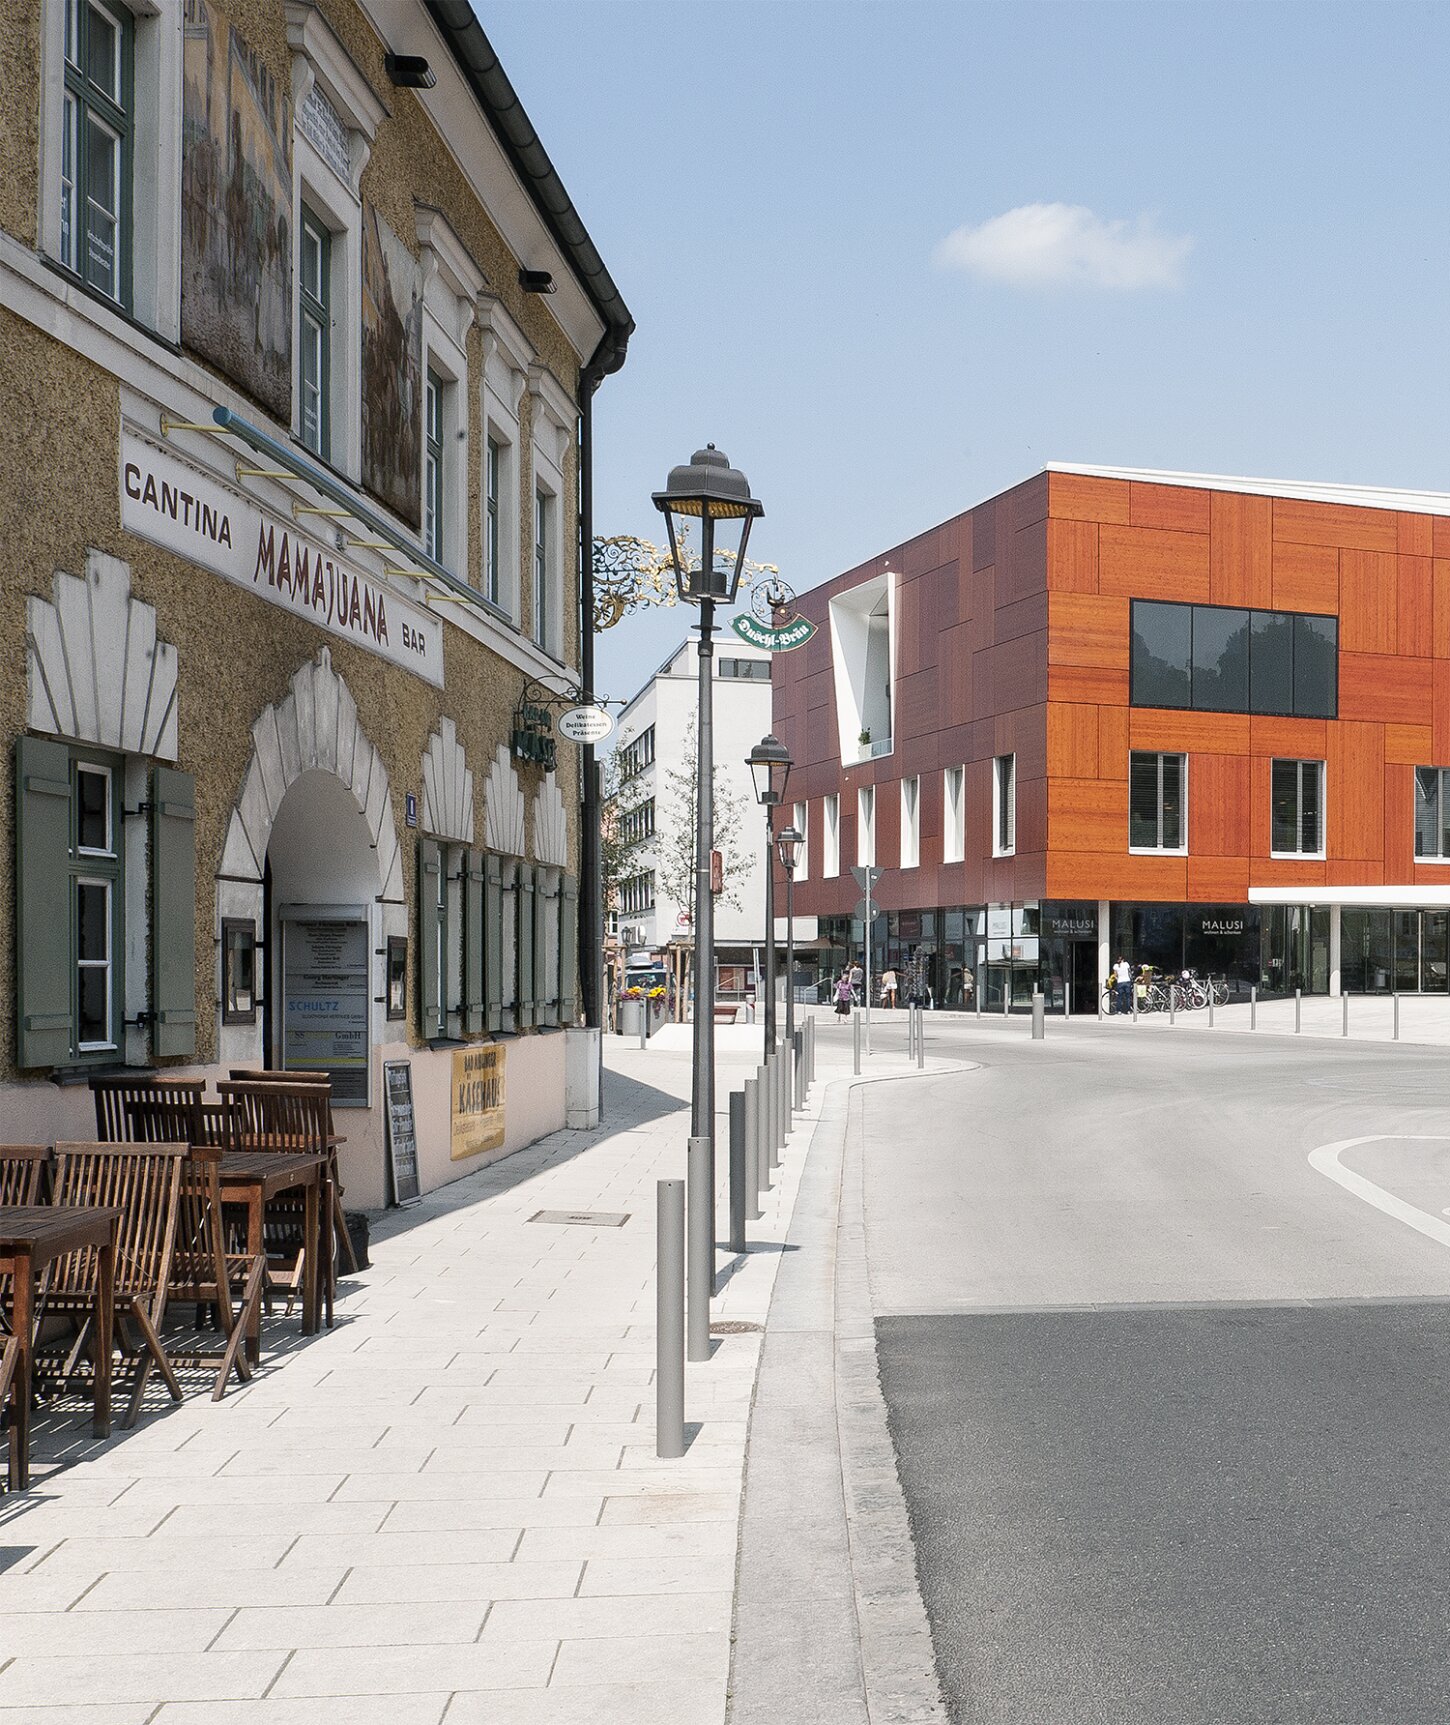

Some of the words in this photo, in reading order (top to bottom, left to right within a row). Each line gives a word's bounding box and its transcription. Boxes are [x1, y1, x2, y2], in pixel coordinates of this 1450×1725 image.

[124, 462, 232, 550] CANTINA
[253, 517, 390, 647] MAMAJUANA
[401, 622, 426, 658] BAR
[1052, 919, 1094, 929] MALUSI
[1202, 920, 1243, 930] MALUSI
[288, 1001, 339, 1011] SCHULTZ
[335, 1031, 361, 1040] GmbH
